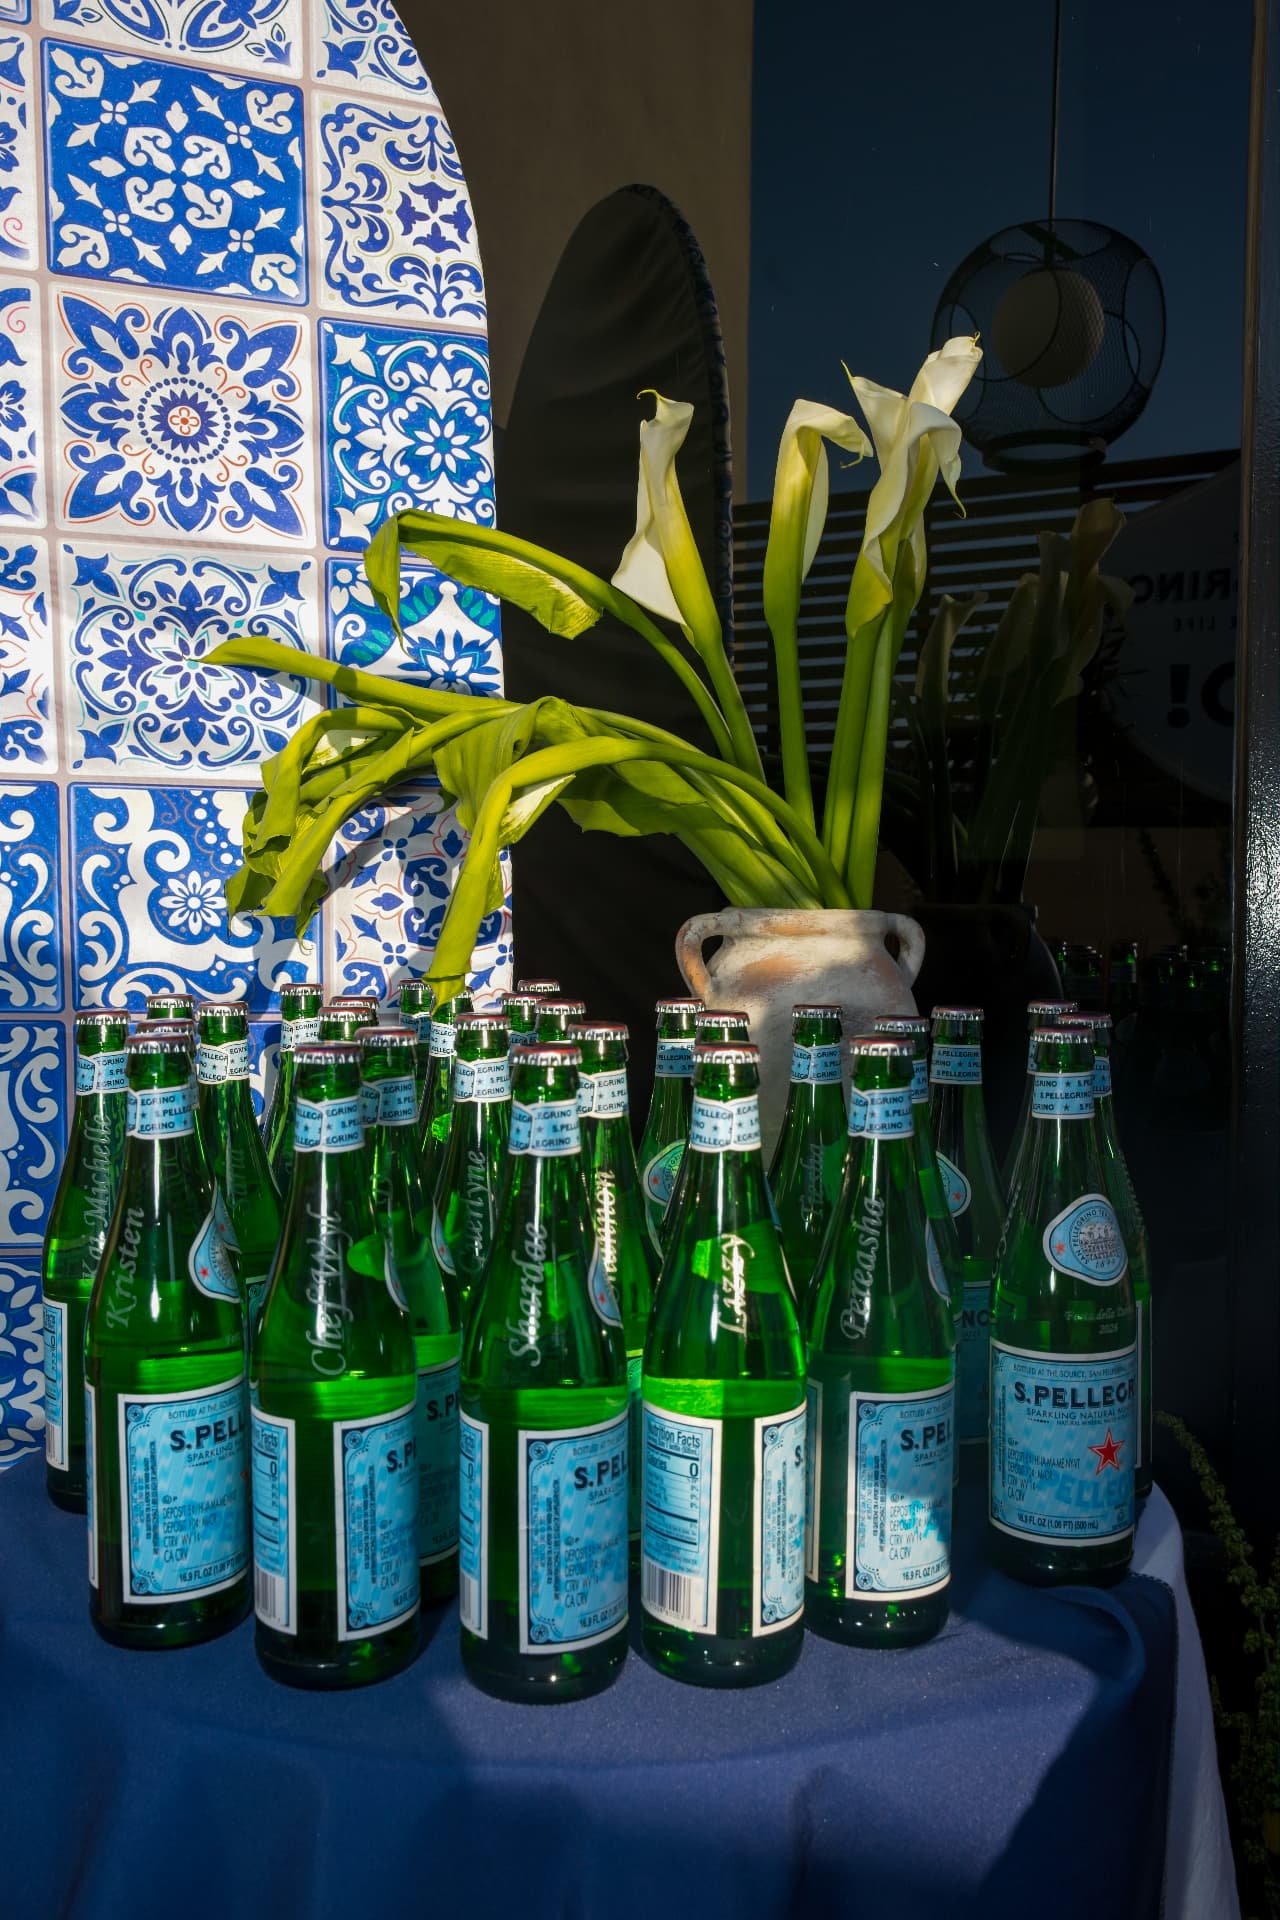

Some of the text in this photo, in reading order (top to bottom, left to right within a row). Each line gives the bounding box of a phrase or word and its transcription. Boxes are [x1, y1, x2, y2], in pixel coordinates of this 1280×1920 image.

[83, 1113, 113, 1228] Michelle
[106, 1206, 145, 1329] Kristen
[717, 1232, 756, 1338] Lizzy
[306, 1287, 354, 1376] Chef
[677, 1431, 701, 1449] Facts
[689, 1462, 699, 1478] 0
[194, 1569, 202, 1580] FL
[203, 1566, 213, 1578] OZ
